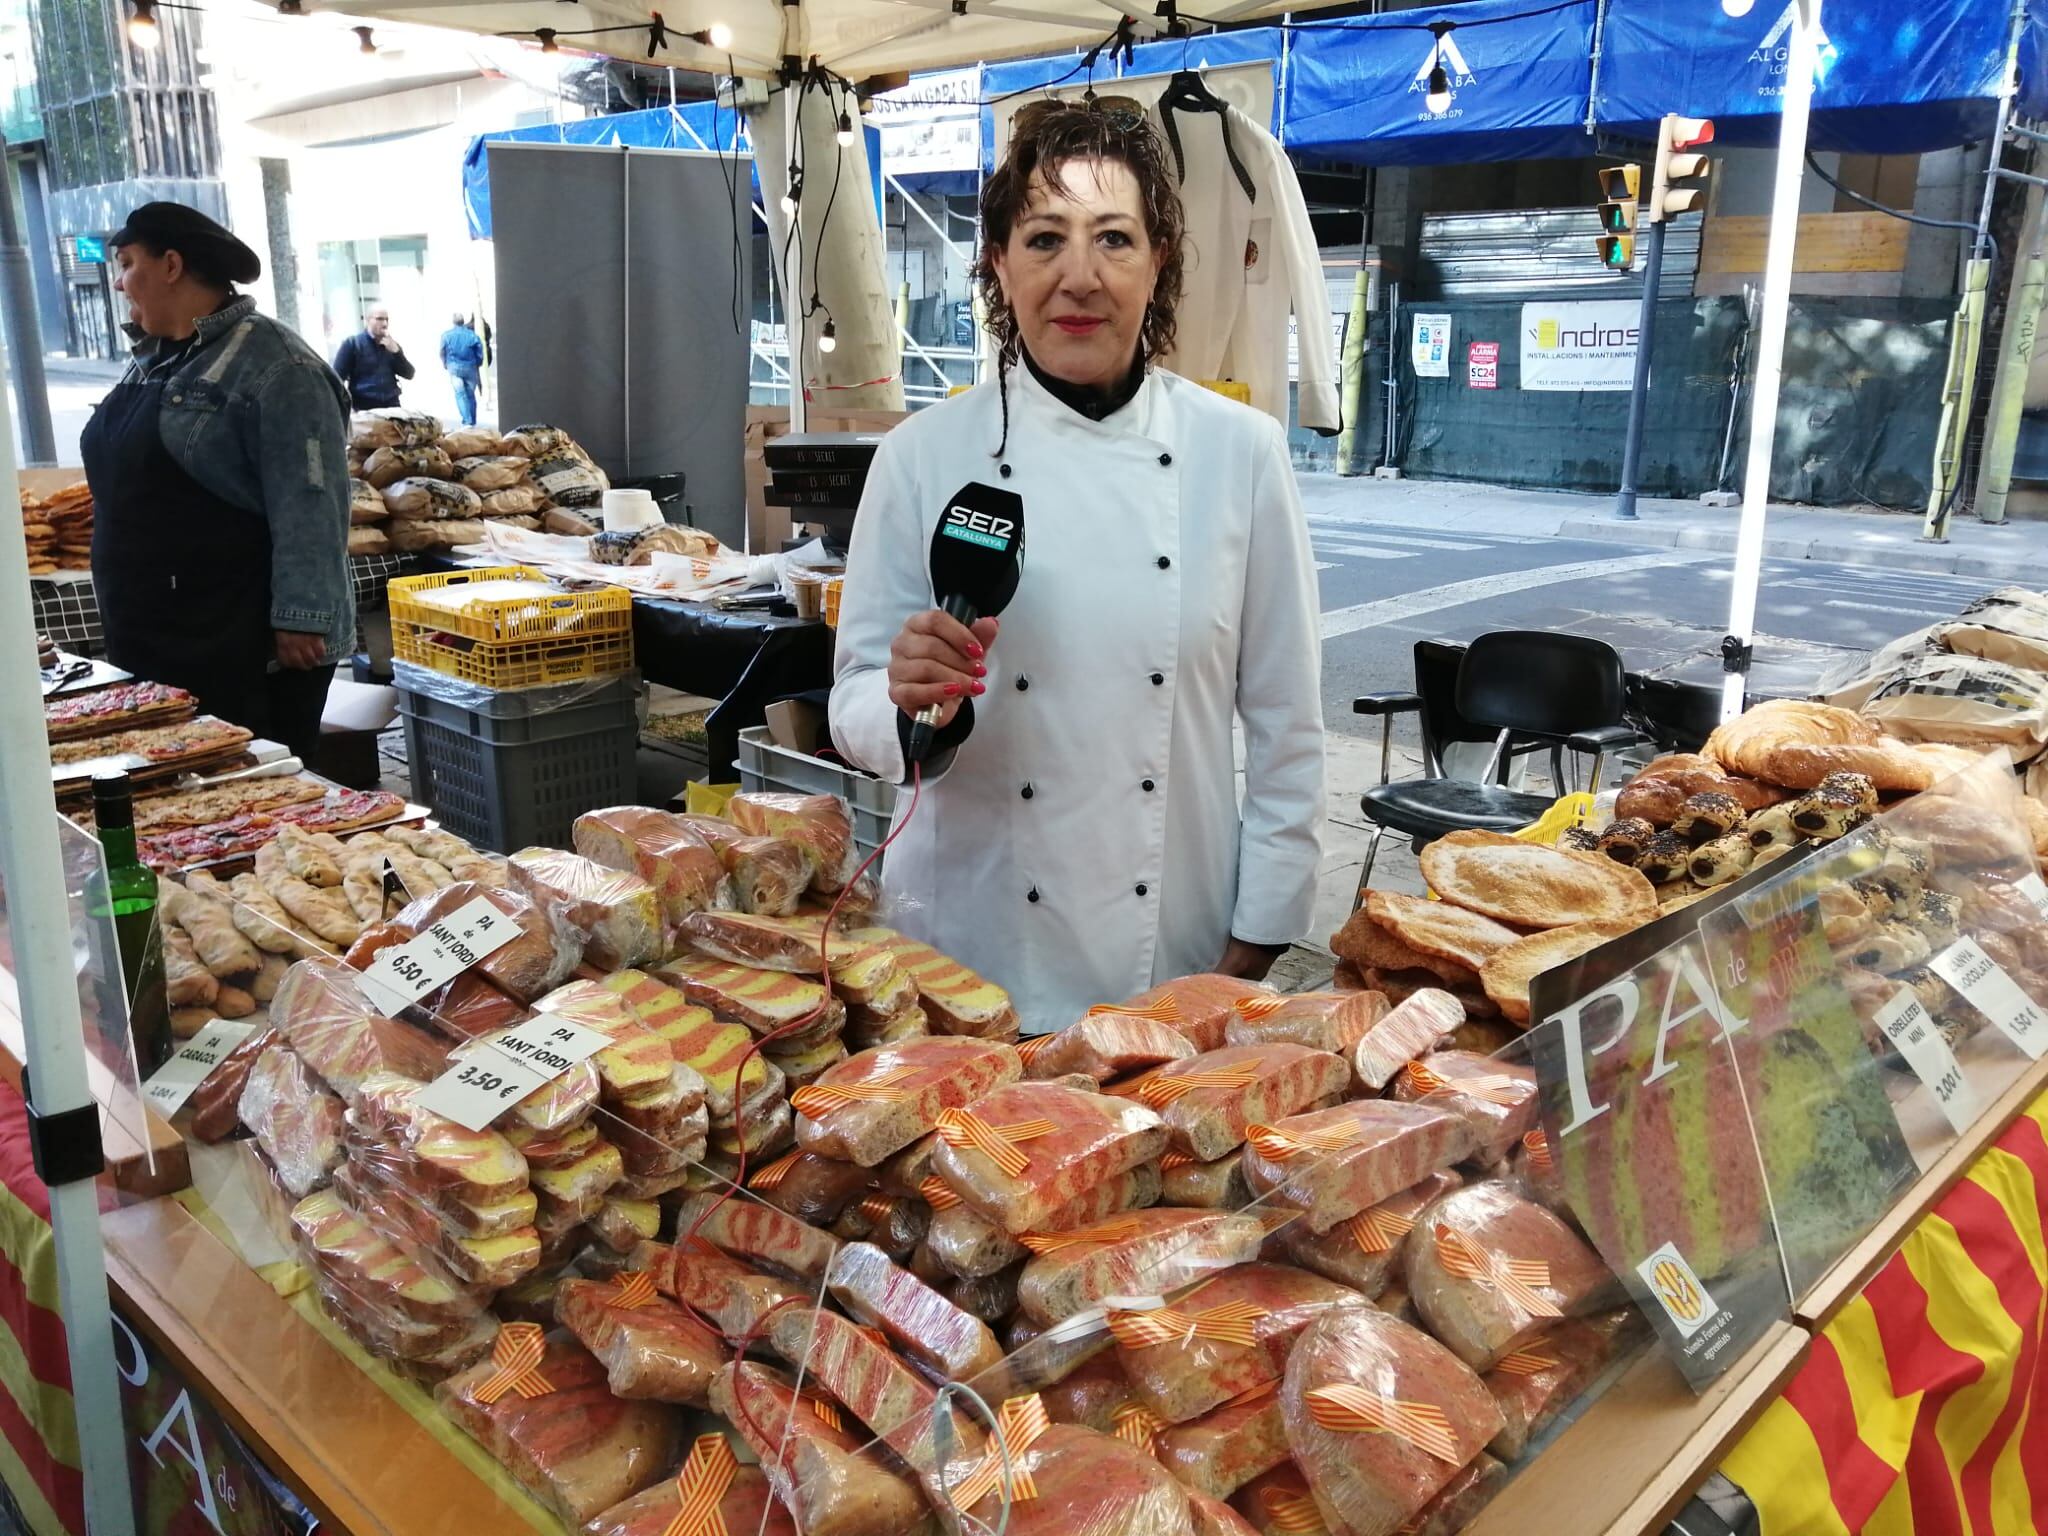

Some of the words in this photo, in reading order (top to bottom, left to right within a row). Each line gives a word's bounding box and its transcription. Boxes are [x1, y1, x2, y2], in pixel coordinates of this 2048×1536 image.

[1408, 74, 1477, 93] ALBA
[1418, 112, 1432, 121] 936
[1449, 109, 1463, 118] 079
[947, 505, 1014, 539] SER
[946, 526, 1002, 548] CATALUNYA
[463, 929, 474, 939] de
[476, 915, 495, 931] PA
[429, 923, 456, 945] SANT
[450, 940, 479, 966] JORDI
[392, 955, 423, 981] 6,50
[415, 978, 432, 991] €
[1887, 1002, 1921, 1039] ORELLETES
[205, 1037, 221, 1048] PA
[551, 1028, 576, 1042] PA
[1544, 945, 1749, 1137] PA
[1726, 951, 1747, 989] de
[1907, 1026, 1926, 1046] MINI
[179, 1048, 219, 1065] CARAGOL
[496, 1035, 536, 1054] SANT
[531, 1047, 574, 1071] JORDI
[457, 1065, 503, 1091] 3,50
[499, 1085, 519, 1099] €
[1935, 1073, 1956, 1103] 2,00
[217, 1465, 236, 1512] de
